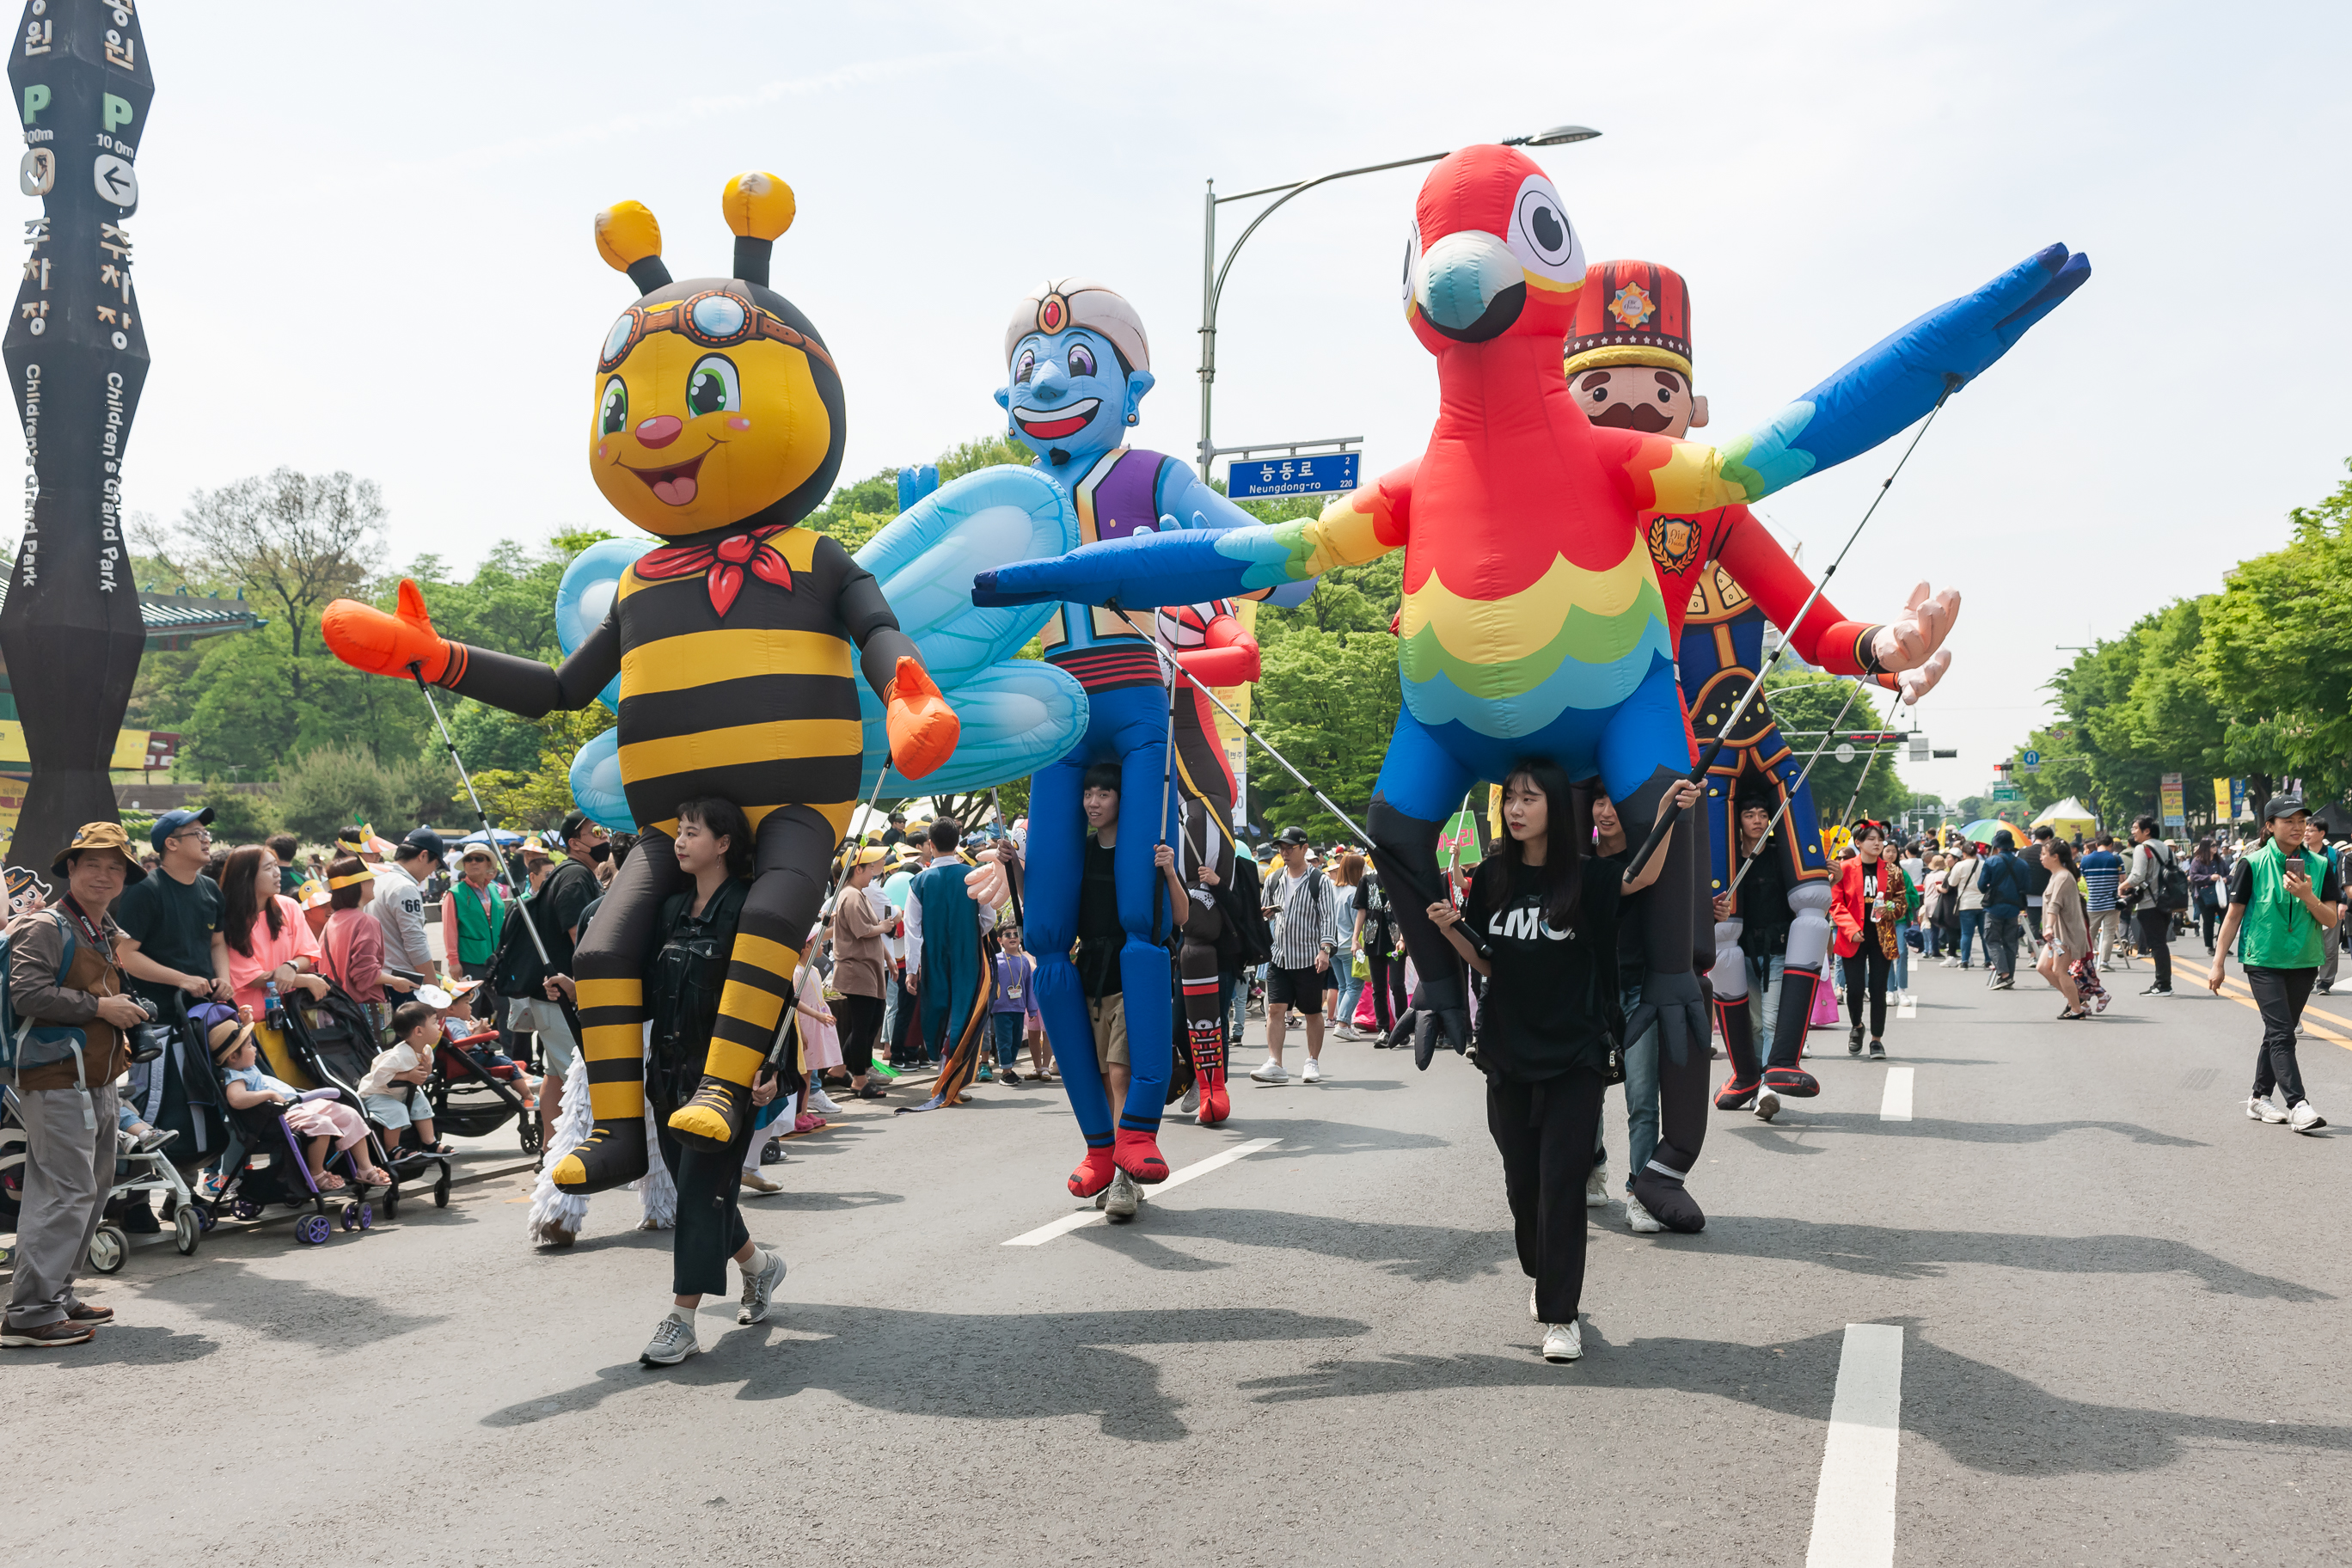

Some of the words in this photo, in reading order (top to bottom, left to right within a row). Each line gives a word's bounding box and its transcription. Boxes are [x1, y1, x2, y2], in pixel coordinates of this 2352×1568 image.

[23, 84, 52, 125] P
[102, 92, 133, 133] P
[21, 217, 52, 336] 주차장
[96, 222, 132, 351] 주차장
[25, 364, 41, 467] Children's
[102, 372, 124, 474] Children's
[1260, 461, 1314, 482] 능동로
[1339, 479, 1353, 488] 220
[1344, 456, 1351, 465] 2
[25, 474, 40, 535] Grand
[101, 476, 122, 542] Grand
[1249, 481, 1321, 495] Neungdong-ro
[22, 539, 38, 587] Park
[99, 546, 119, 593] Park
[80, 916, 96, 937] Canon
